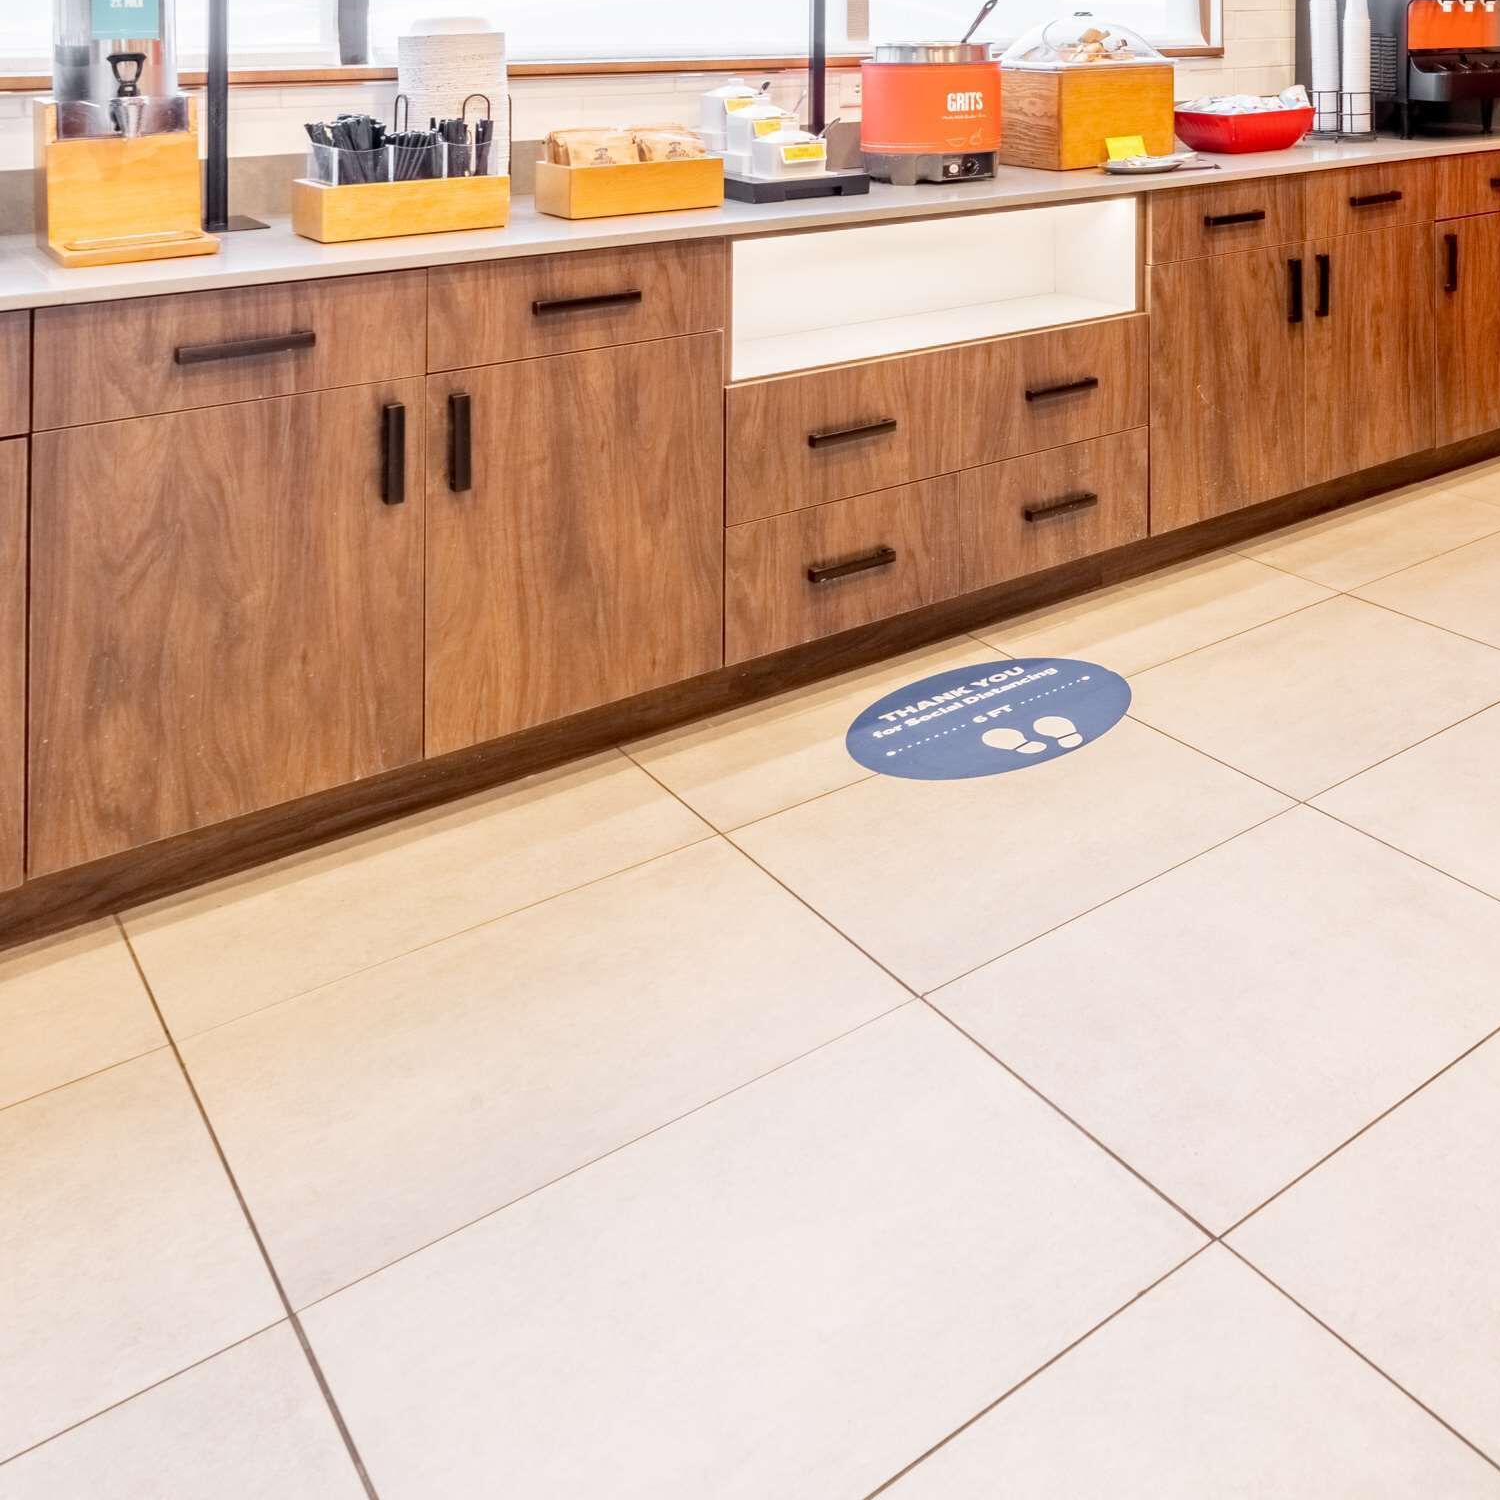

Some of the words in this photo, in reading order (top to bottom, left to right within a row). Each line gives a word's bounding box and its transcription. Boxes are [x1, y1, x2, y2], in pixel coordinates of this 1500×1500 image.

[946, 91, 983, 113] GRITS
[872, 724, 903, 739] for
[904, 702, 965, 727] Social
[962, 667, 1059, 705] Distancing
[877, 686, 974, 722] THANK
[970, 666, 1025, 688] YOU
[972, 715, 988, 724] 6
[985, 704, 1014, 718] FT
